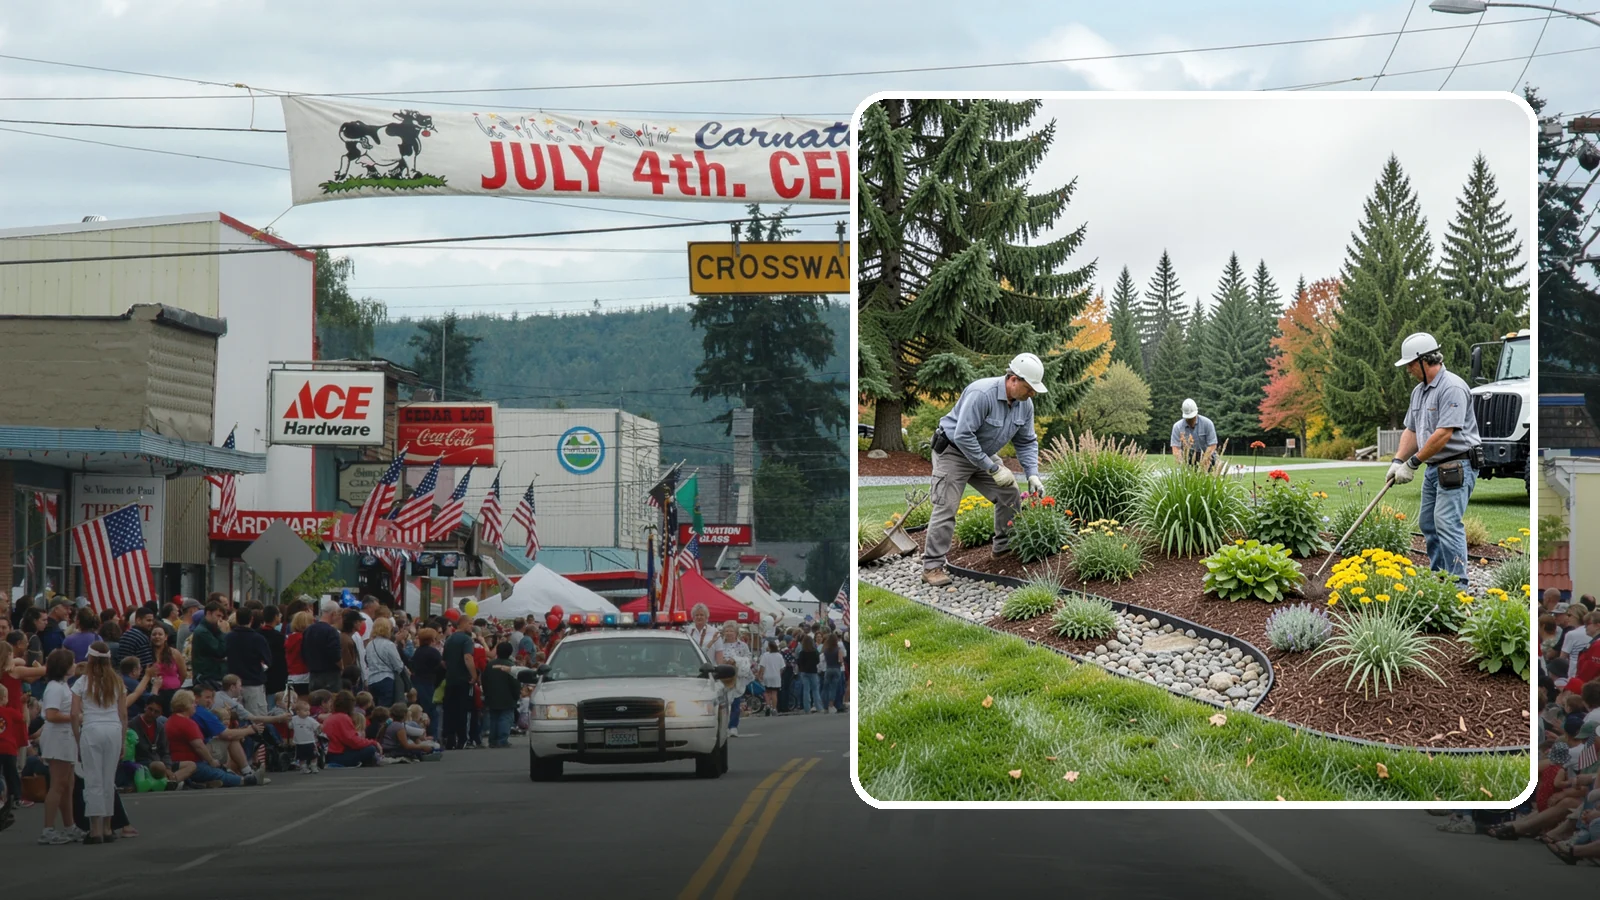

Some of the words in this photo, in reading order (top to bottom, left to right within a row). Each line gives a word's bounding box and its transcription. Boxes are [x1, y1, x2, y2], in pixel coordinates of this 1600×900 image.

[481, 141, 604, 192] JULY
[632, 150, 746, 198] 4th.
[696, 254, 850, 280] CROSSWA
[283, 380, 373, 420] ACE
[406, 409, 452, 421] CEDAR
[283, 421, 371, 436] Hardware
[354, 467, 387, 481] Simpl
[83, 485, 93, 494] St.
[95, 485, 124, 495] Vincent
[126, 485, 136, 495] de
[137, 486, 155, 495] Paul
[688, 526, 742, 535] CRNATION
[698, 535, 730, 543] GLASS
